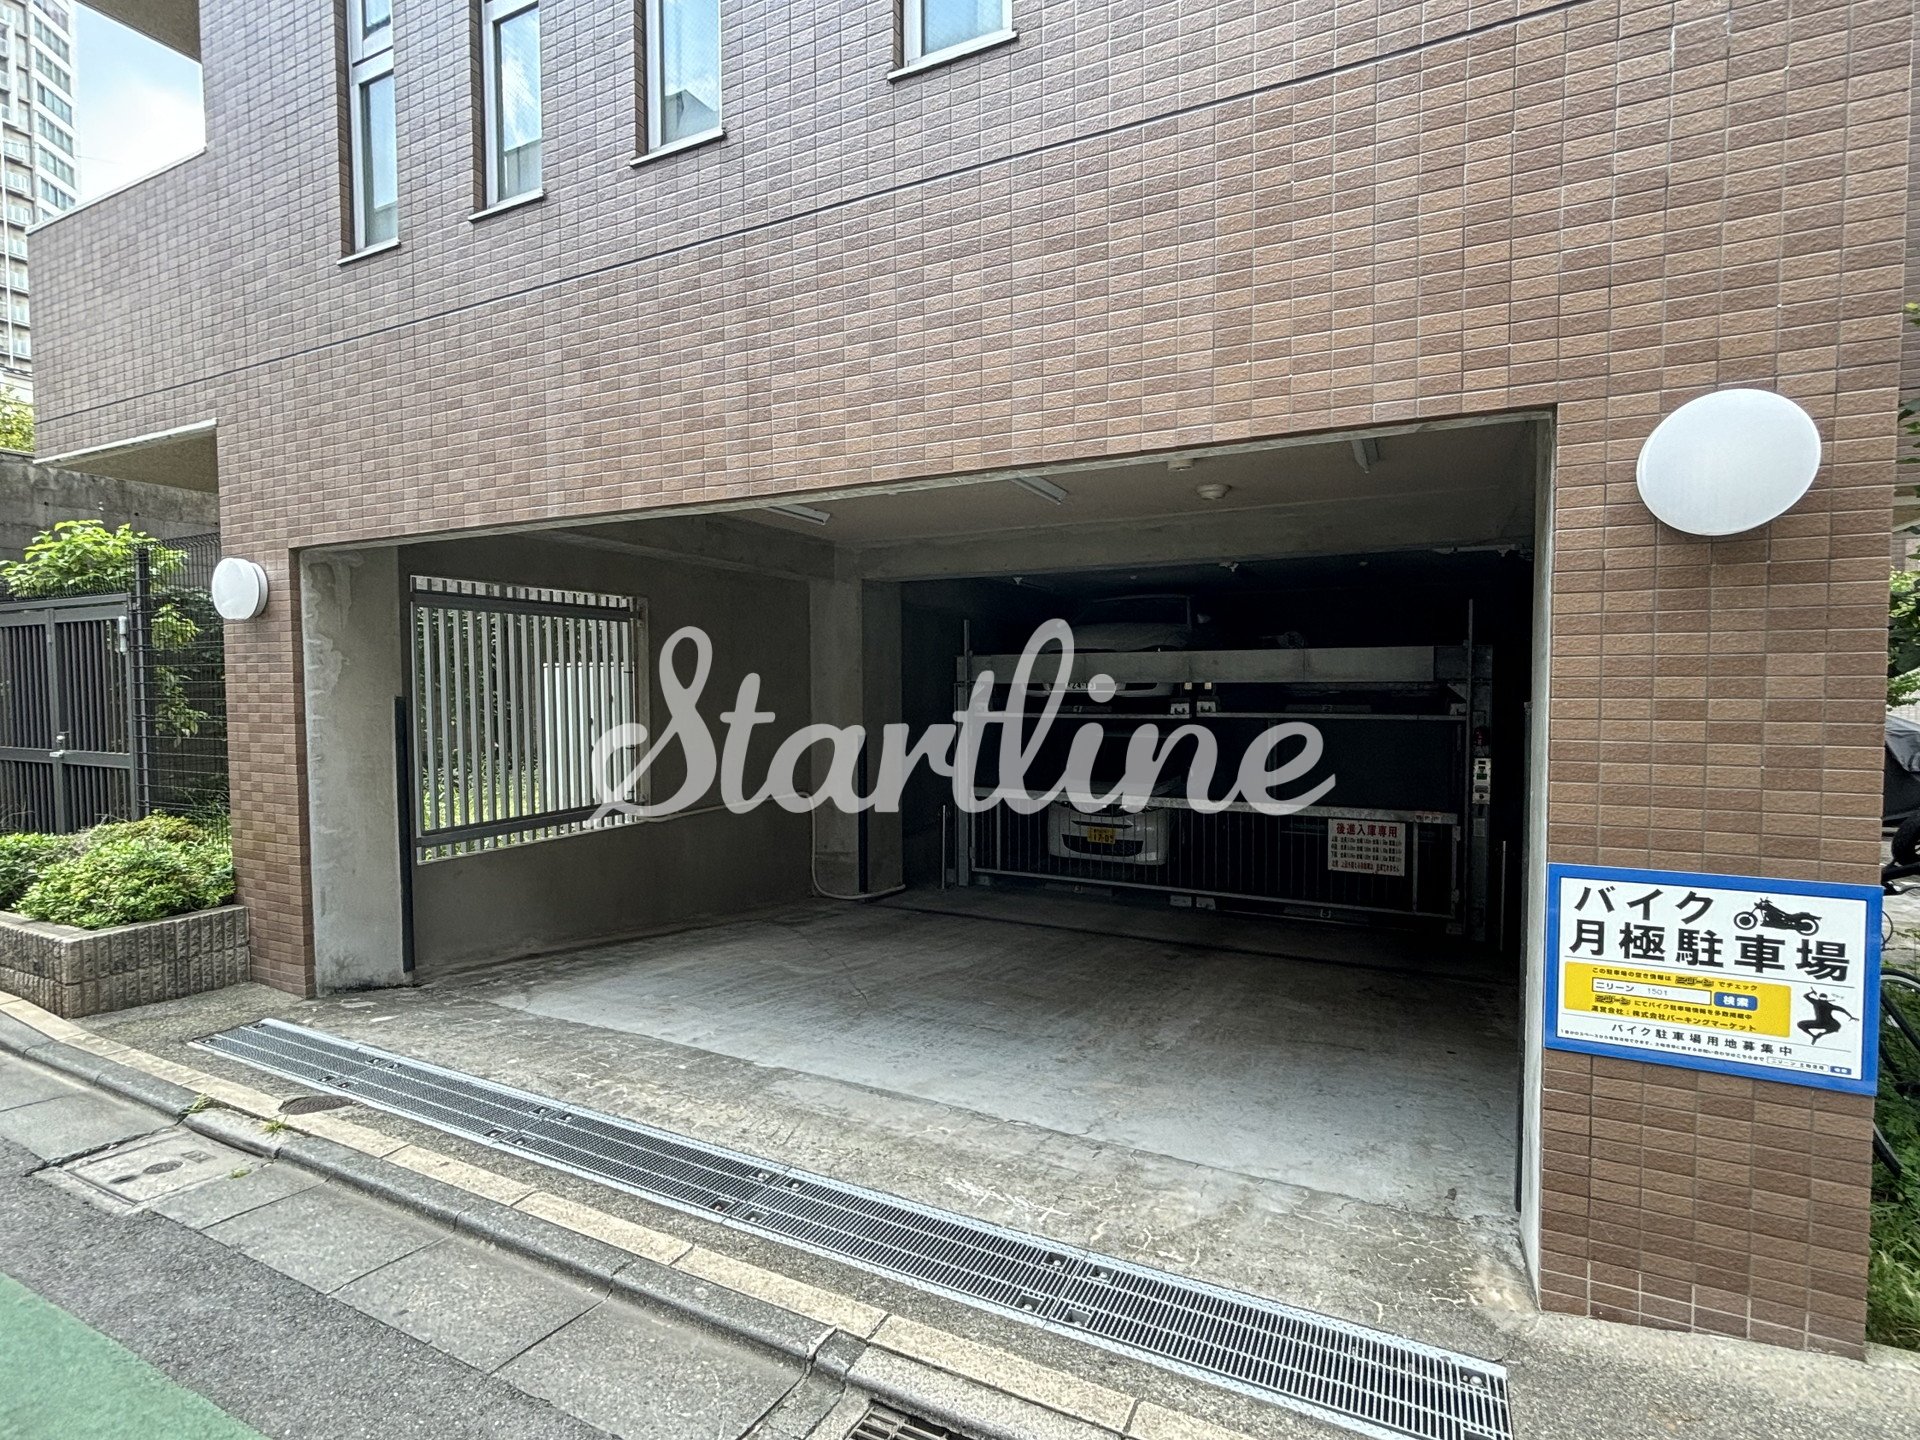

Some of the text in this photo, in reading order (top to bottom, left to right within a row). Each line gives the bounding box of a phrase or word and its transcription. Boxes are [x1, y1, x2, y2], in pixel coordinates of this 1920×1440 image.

[1336, 822, 1398, 838] 後進入庫専用
[1574, 885, 1714, 924] バイク
[1569, 919, 1850, 982] 月極駐車場
[1595, 981, 1635, 992] ニリーン
[1718, 981, 1758, 991] でチェック
[1723, 995, 1749, 1008] 検索
[1612, 1024, 1793, 1056] バイク駐車場用地募集中
